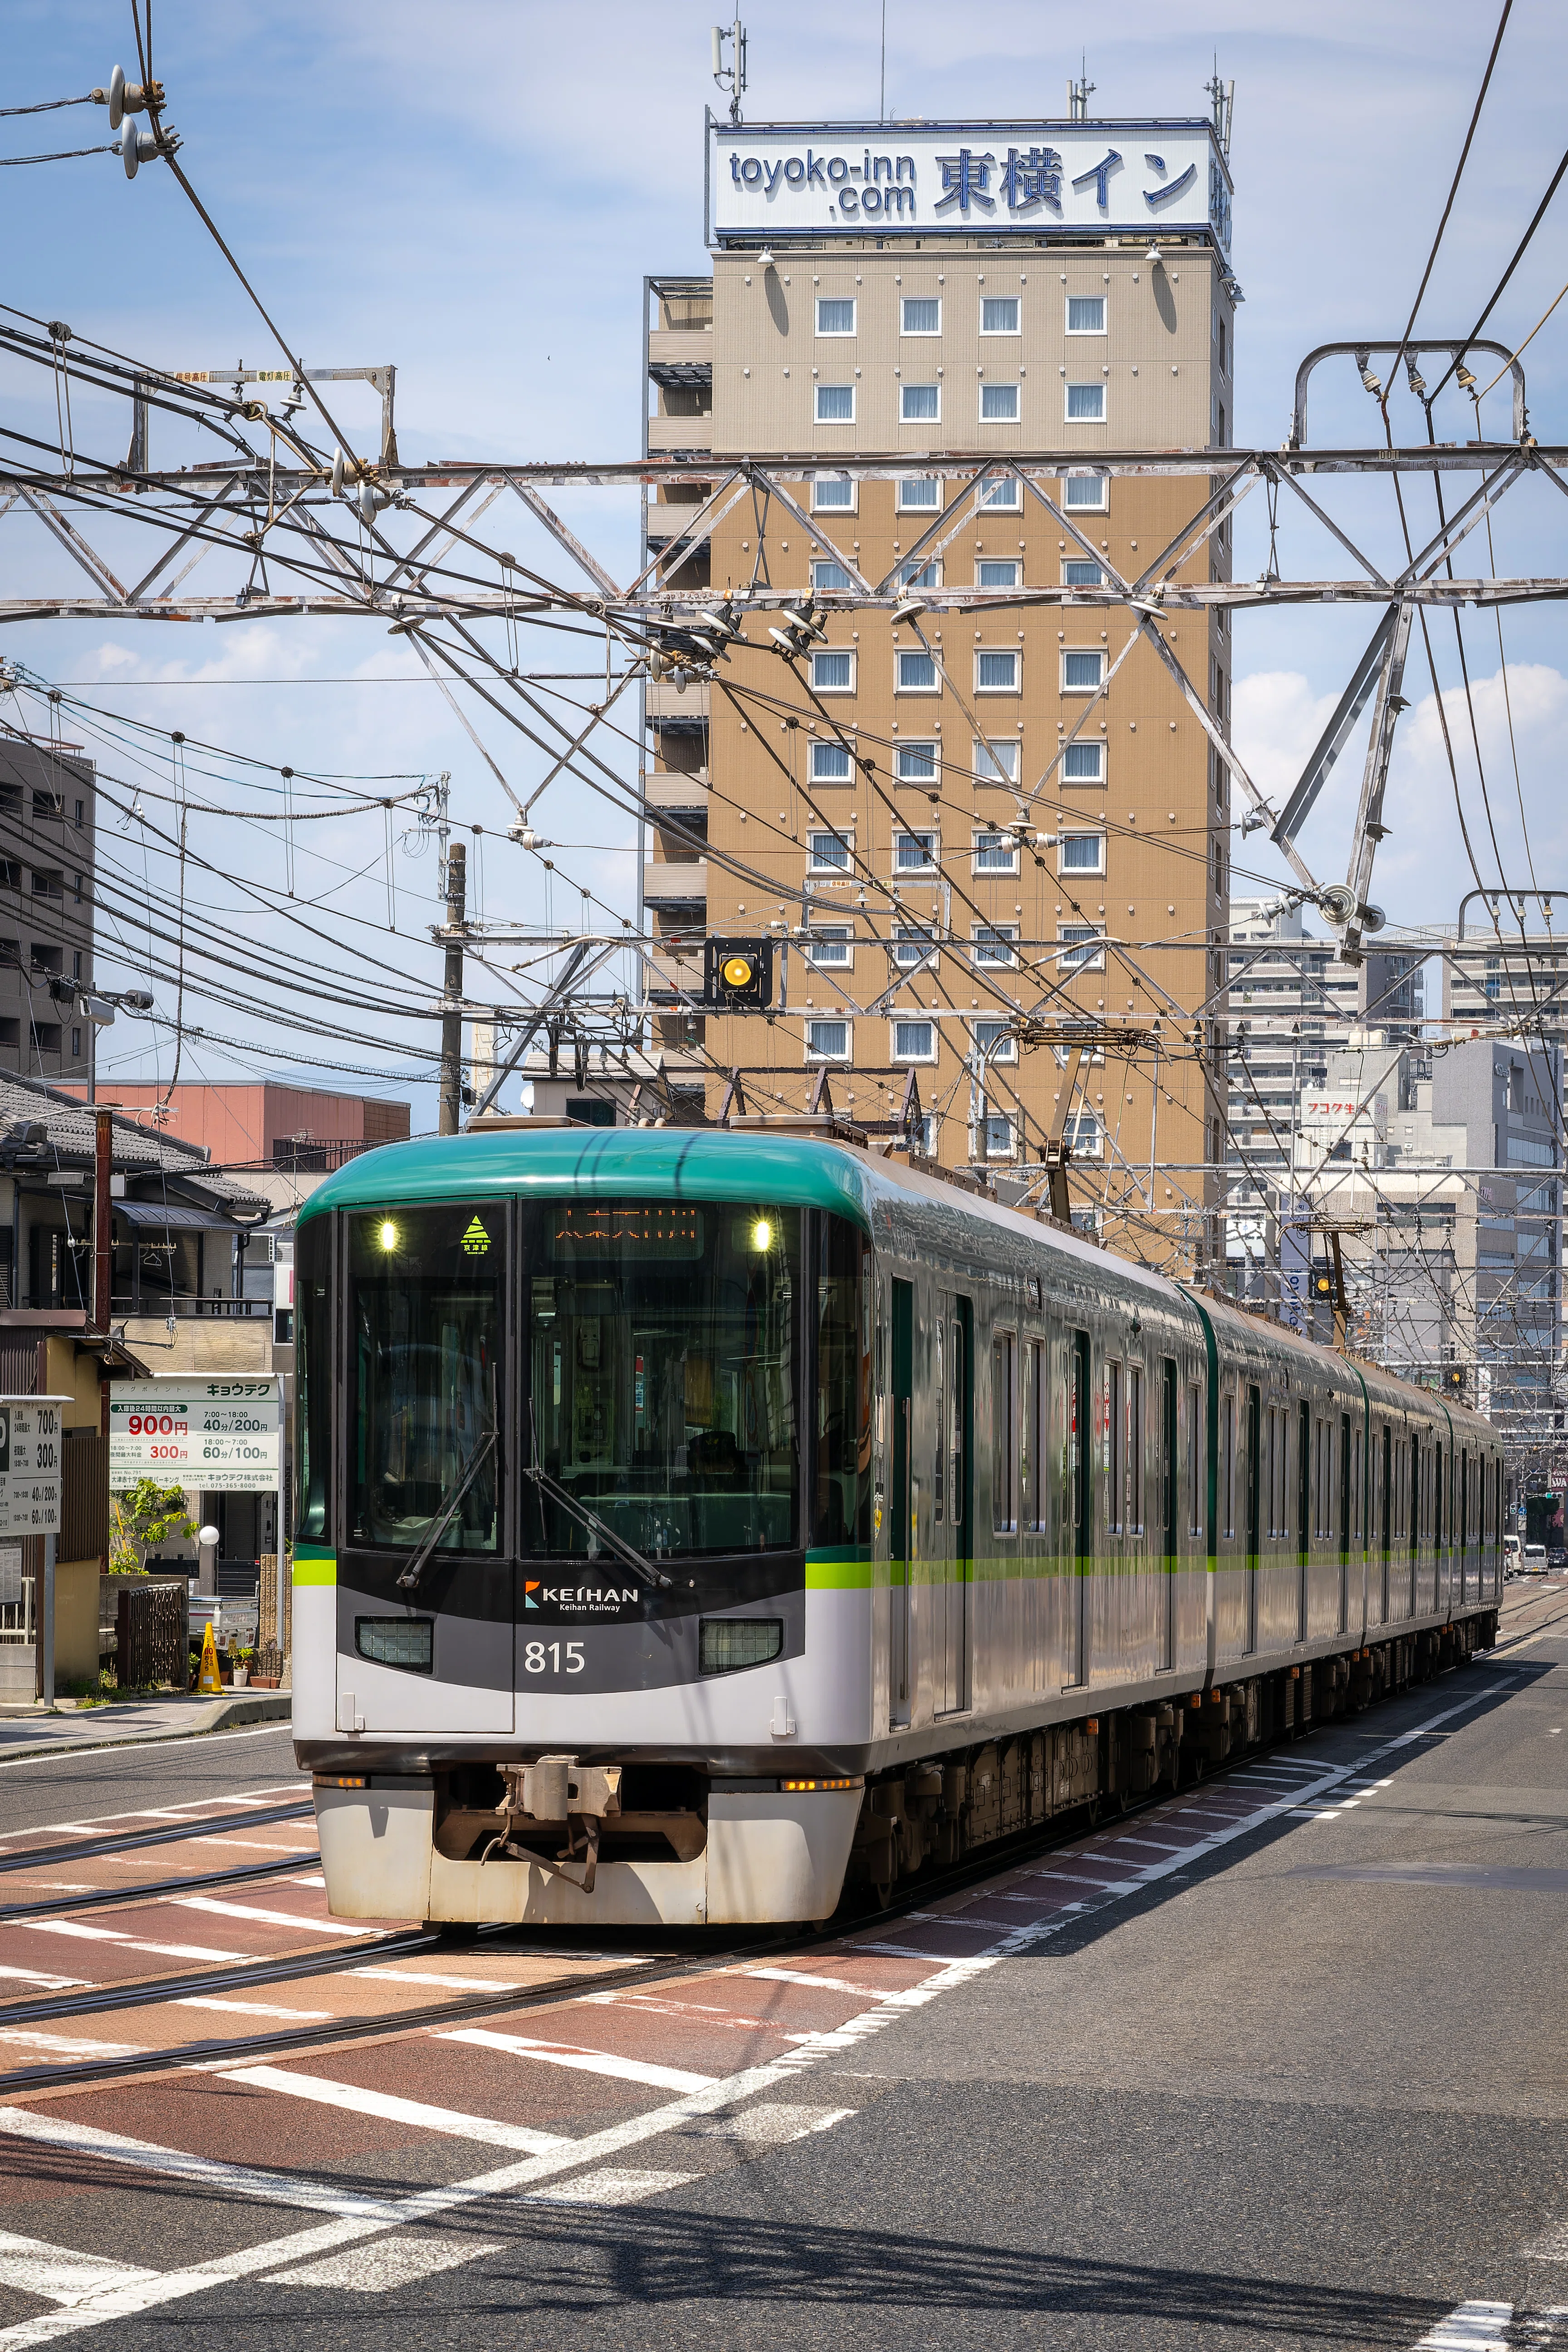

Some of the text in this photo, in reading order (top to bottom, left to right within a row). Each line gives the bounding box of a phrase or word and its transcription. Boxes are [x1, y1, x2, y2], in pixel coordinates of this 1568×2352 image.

[730, 147, 915, 192] toyoko-inn
[934, 147, 1196, 211] 東横イン
[828, 185, 915, 211] .com
[259, 371, 291, 382] 電灯高圧
[207, 1383, 270, 1396] キョウテク
[37, 1409, 58, 1435] 700円
[128, 1415, 188, 1436] 900円
[203, 1419, 268, 1431] 40分/200円
[37, 1443, 58, 1469] 300円
[150, 1446, 188, 1459] 300円
[203, 1447, 267, 1459] 60分/100円
[208, 1473, 273, 1481] キョウテク株式会社
[543, 1587, 638, 1602] KEIHAN
[589, 1604, 620, 1612] Railway
[524, 1641, 585, 1673] 815
